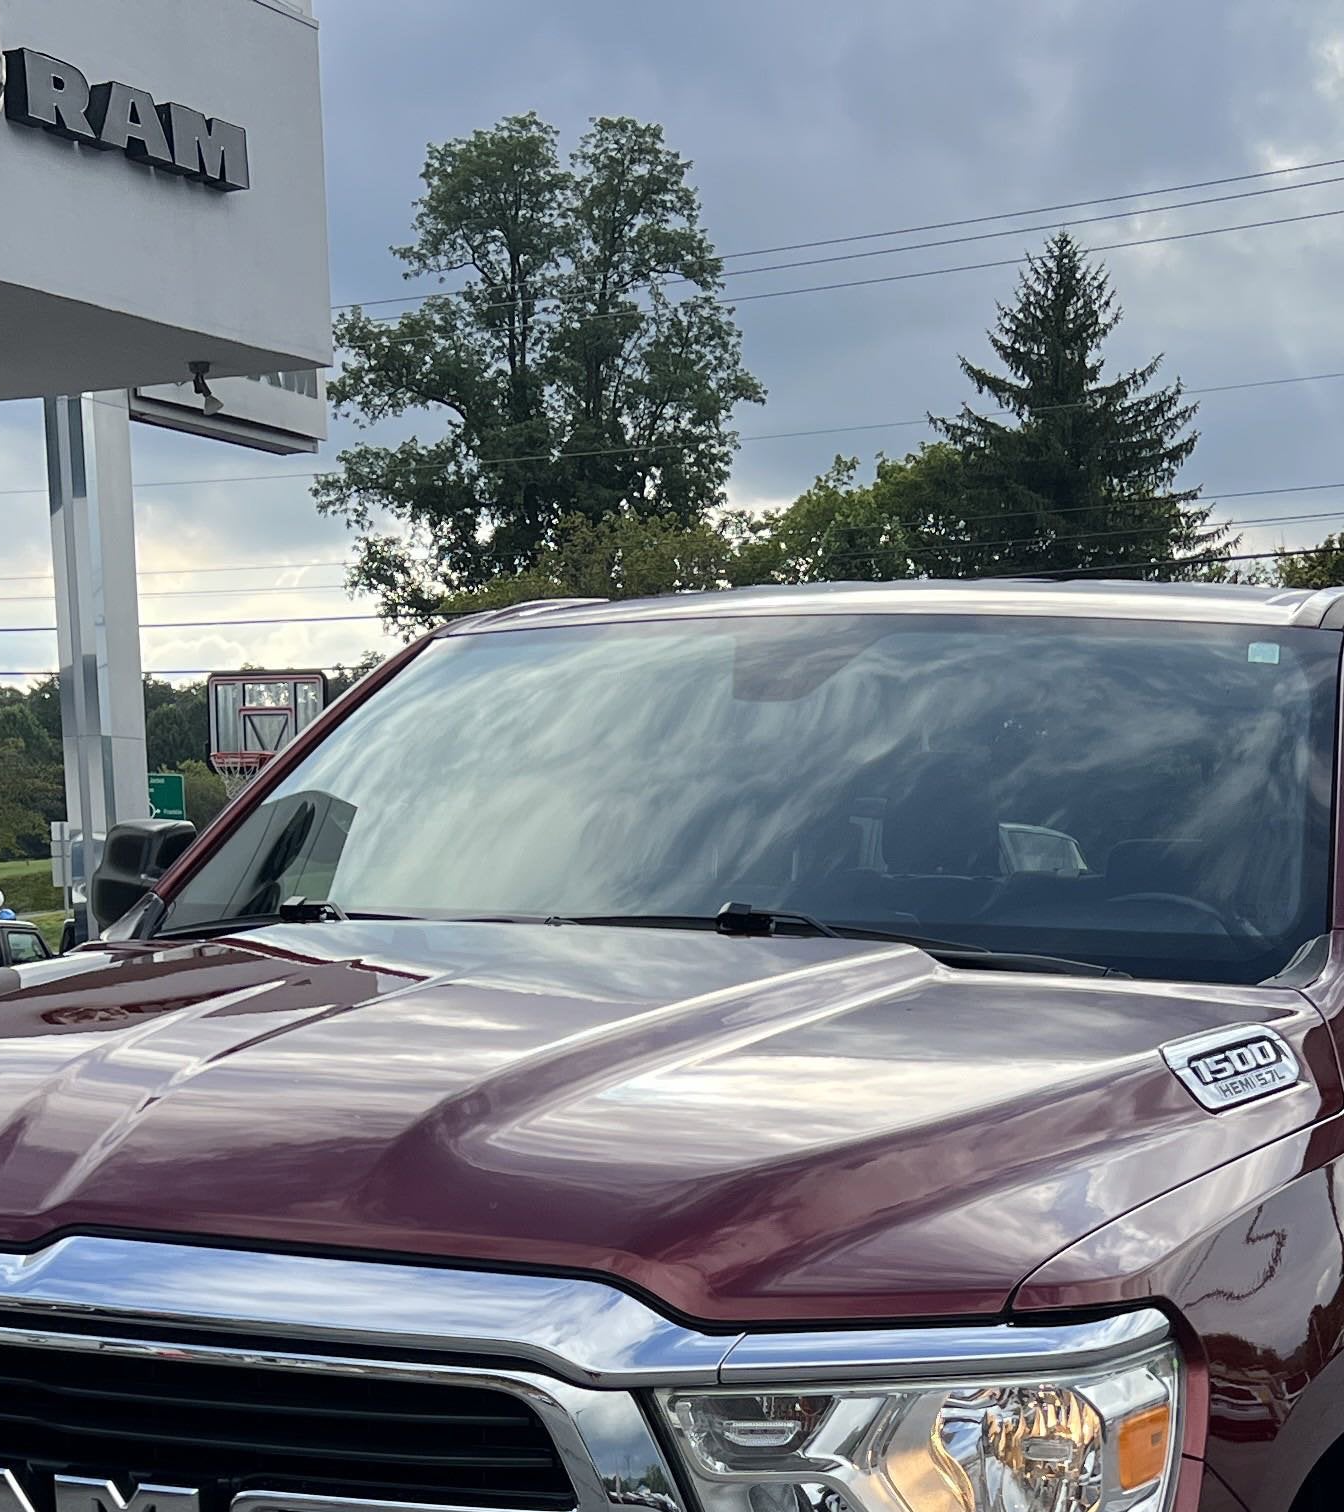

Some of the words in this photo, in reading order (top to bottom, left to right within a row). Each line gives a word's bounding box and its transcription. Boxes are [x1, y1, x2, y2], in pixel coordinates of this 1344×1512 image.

[4, 48, 250, 192] RAM
[1190, 1040, 1277, 1083] 1500
[1218, 1075, 1258, 1098] HEMI
